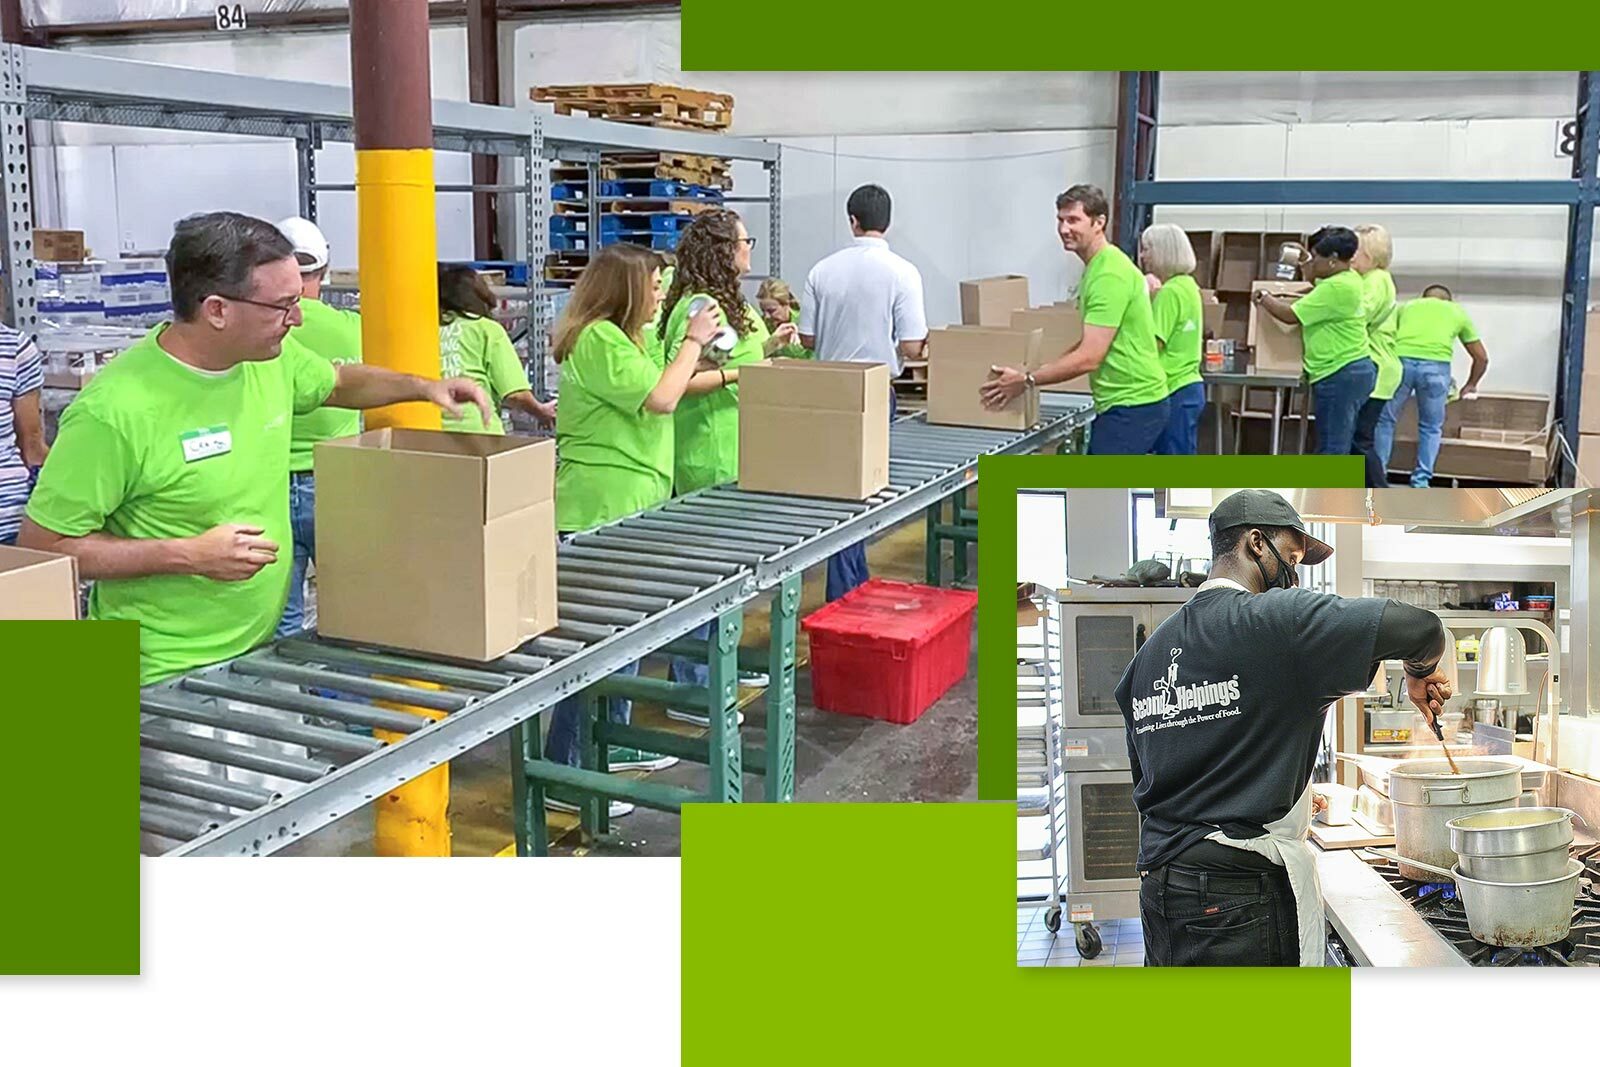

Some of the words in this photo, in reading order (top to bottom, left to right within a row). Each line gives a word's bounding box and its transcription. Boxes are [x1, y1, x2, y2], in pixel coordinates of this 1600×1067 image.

[218, 4, 244, 29] 84
[1132, 690, 1165, 720] Second
[1177, 680, 1240, 711] Helpings
[1197, 714, 1215, 723] Power
[1215, 709, 1223, 719] of
[1222, 706, 1242, 718] Food.
